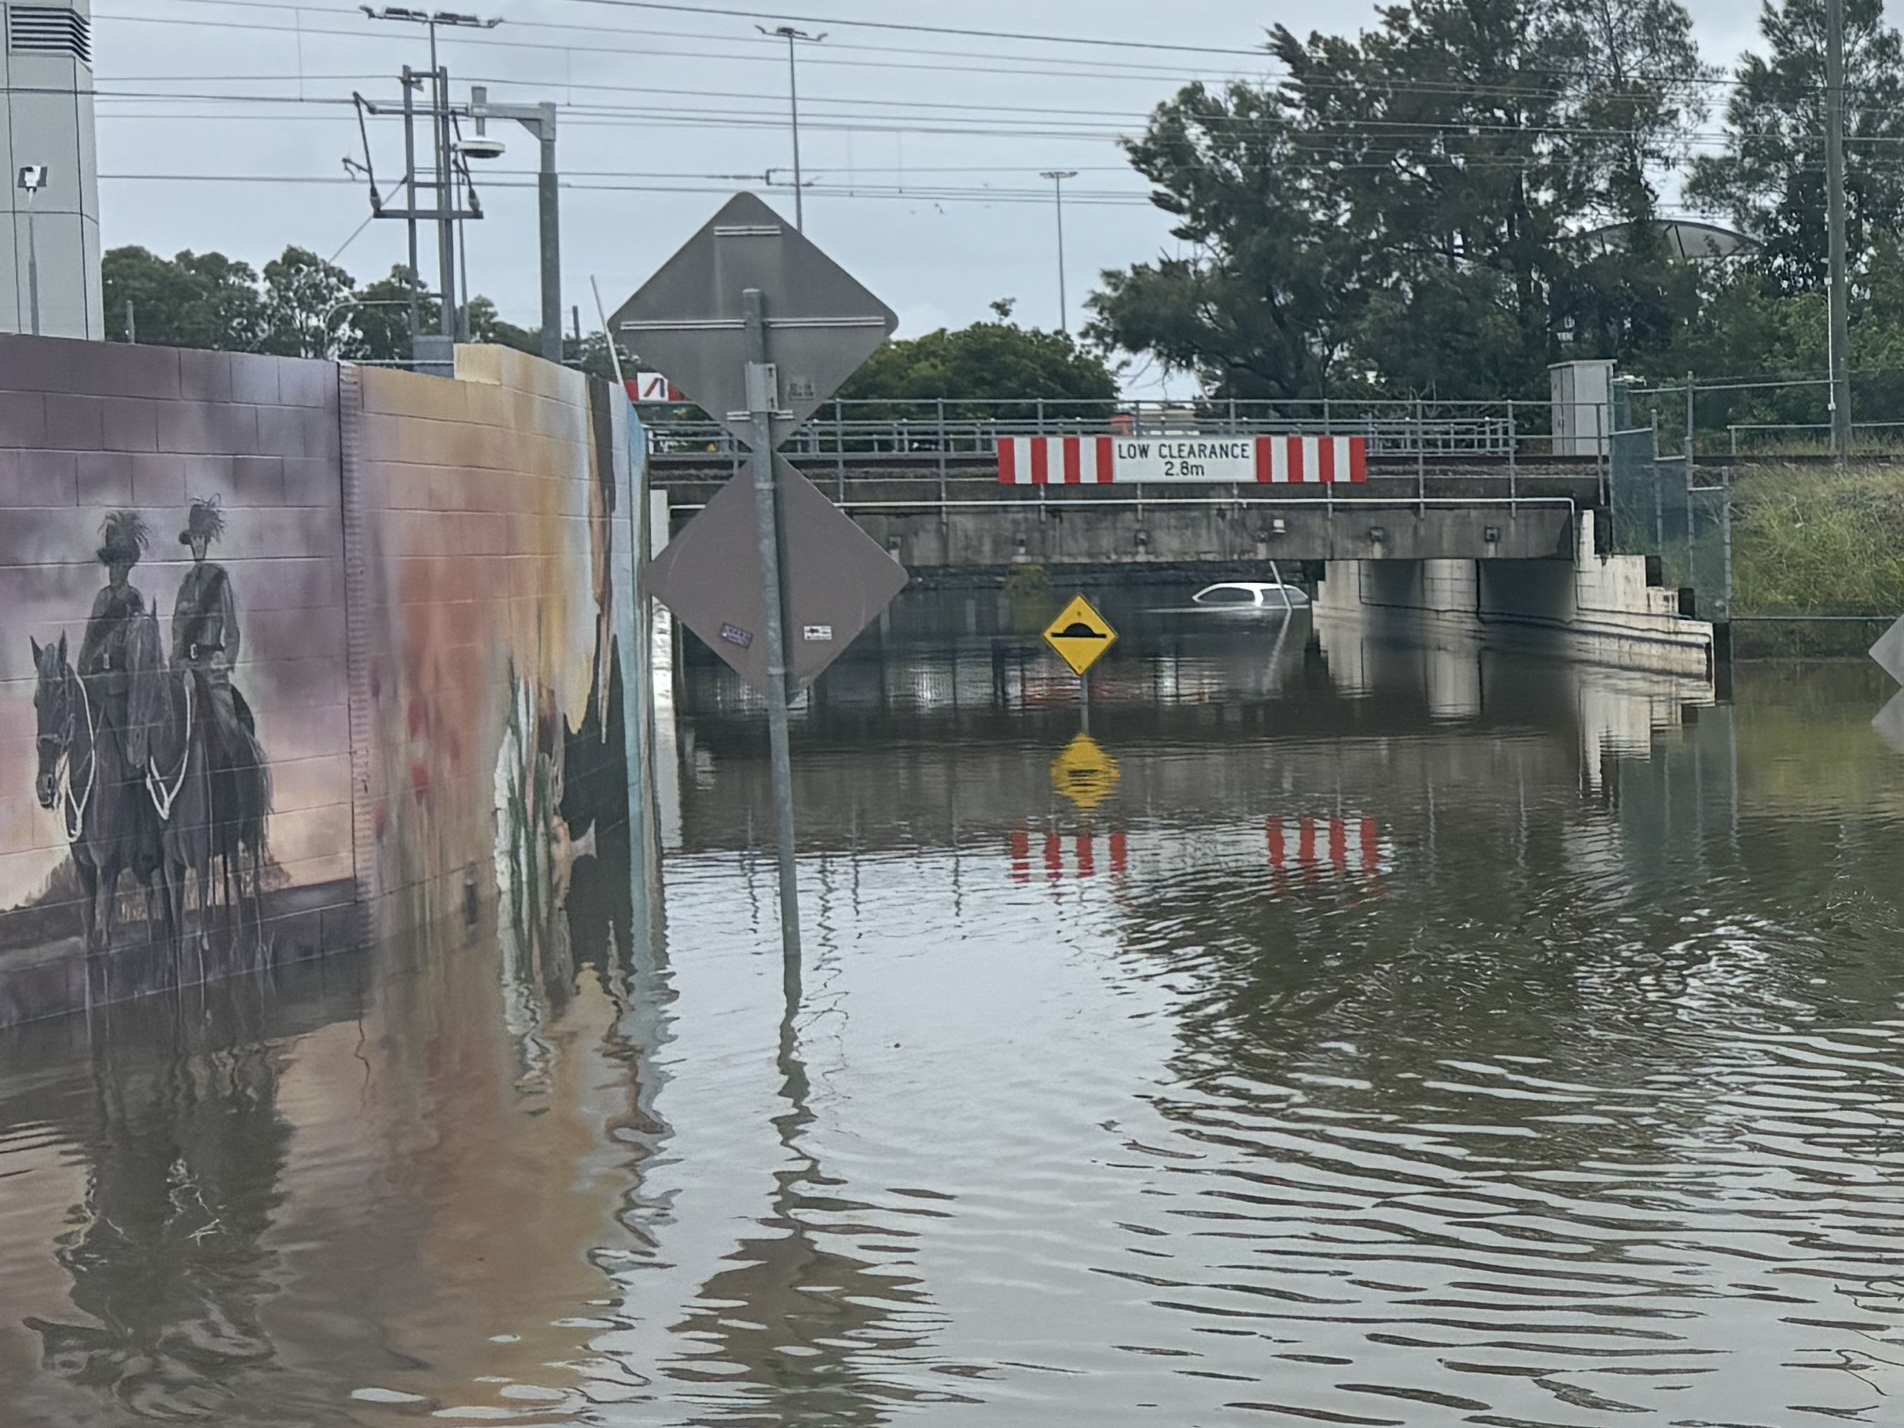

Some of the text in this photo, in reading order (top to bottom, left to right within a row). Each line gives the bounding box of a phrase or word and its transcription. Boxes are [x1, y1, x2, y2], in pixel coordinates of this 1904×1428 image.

[1118, 443, 1250, 459] LOW CLEARANCE
[1164, 460, 1205, 477] 2.8m
